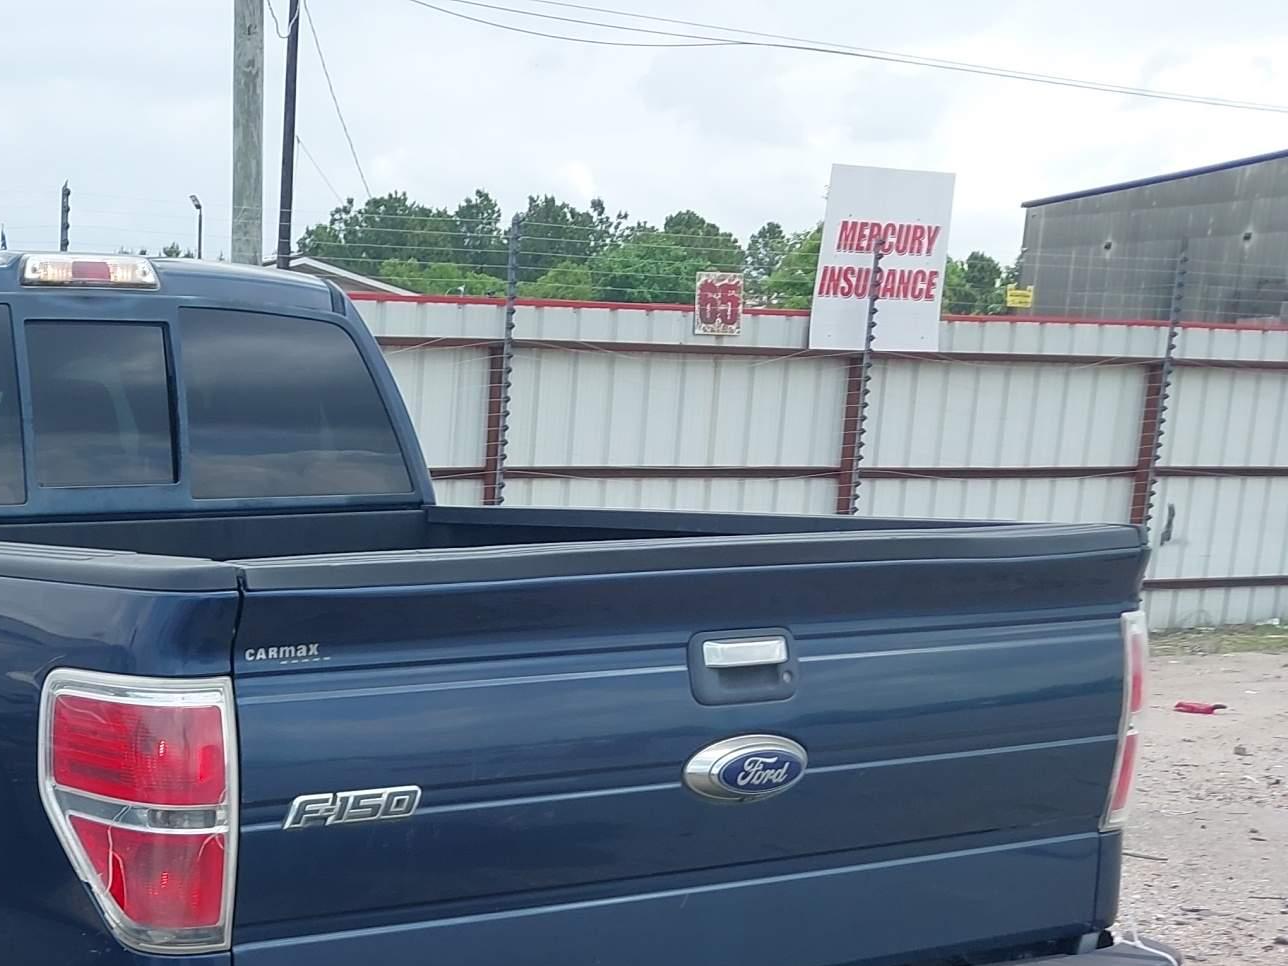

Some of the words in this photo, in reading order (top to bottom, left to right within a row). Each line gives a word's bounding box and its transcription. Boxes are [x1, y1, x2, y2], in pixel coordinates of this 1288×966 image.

[836, 219, 941, 256] MERCURY
[737, 756, 790, 786] Ford
[283, 785, 421, 830] F-150
